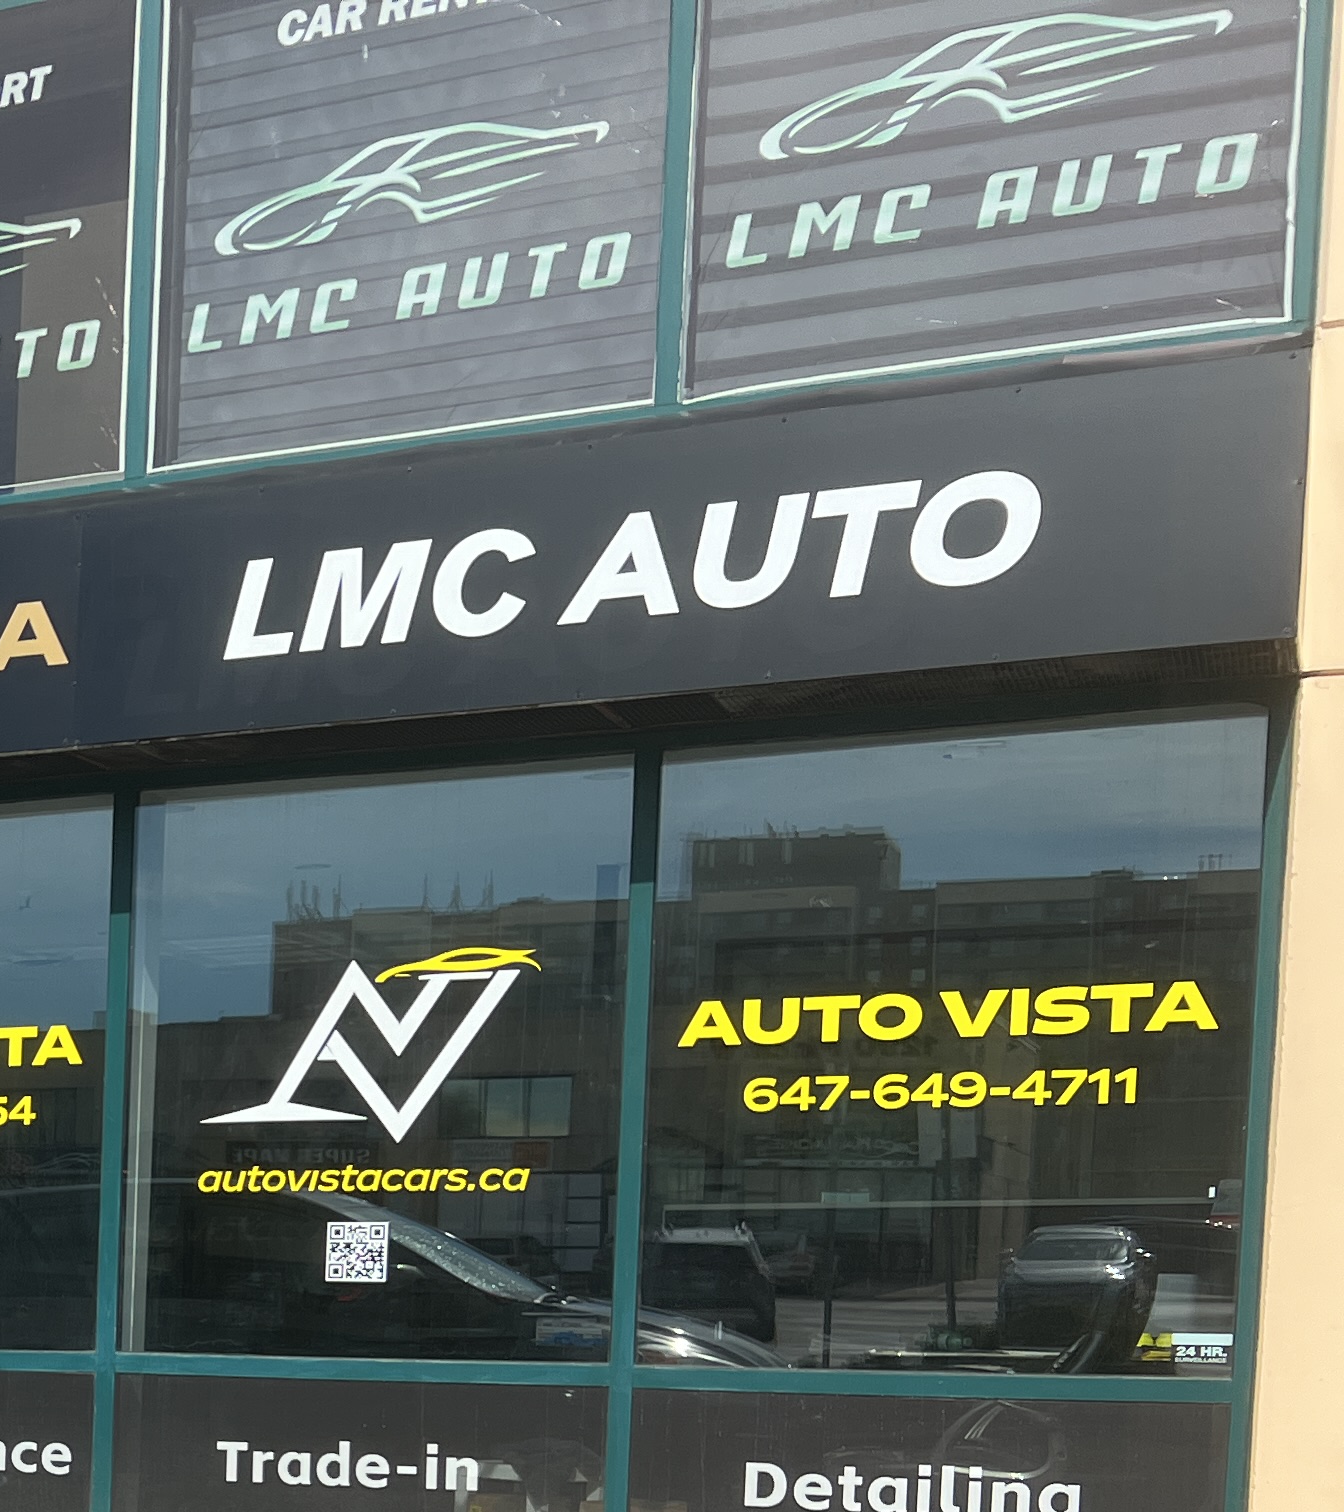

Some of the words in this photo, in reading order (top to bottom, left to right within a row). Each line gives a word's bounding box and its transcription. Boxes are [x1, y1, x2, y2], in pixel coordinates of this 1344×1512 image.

[277, 0, 368, 47] CAR
[377, 0, 489, 26] RE
[725, 186, 930, 269] LMC
[976, 132, 1259, 230] AUTO
[187, 278, 358, 353] LMC
[394, 231, 632, 321] AUTO
[222, 528, 537, 661] LMC
[556, 470, 1042, 626] AUTO
[677, 993, 923, 1048] AUTO
[940, 980, 1219, 1038] VISTA
[743, 1067, 1139, 1113] 647-649-4711
[197, 1164, 531, 1193] autovistacars.ca
[1175, 1345, 1196, 1357] 24
[1200, 1345, 1228, 1357] HR.
[216, 1440, 480, 1492] Trade-in
